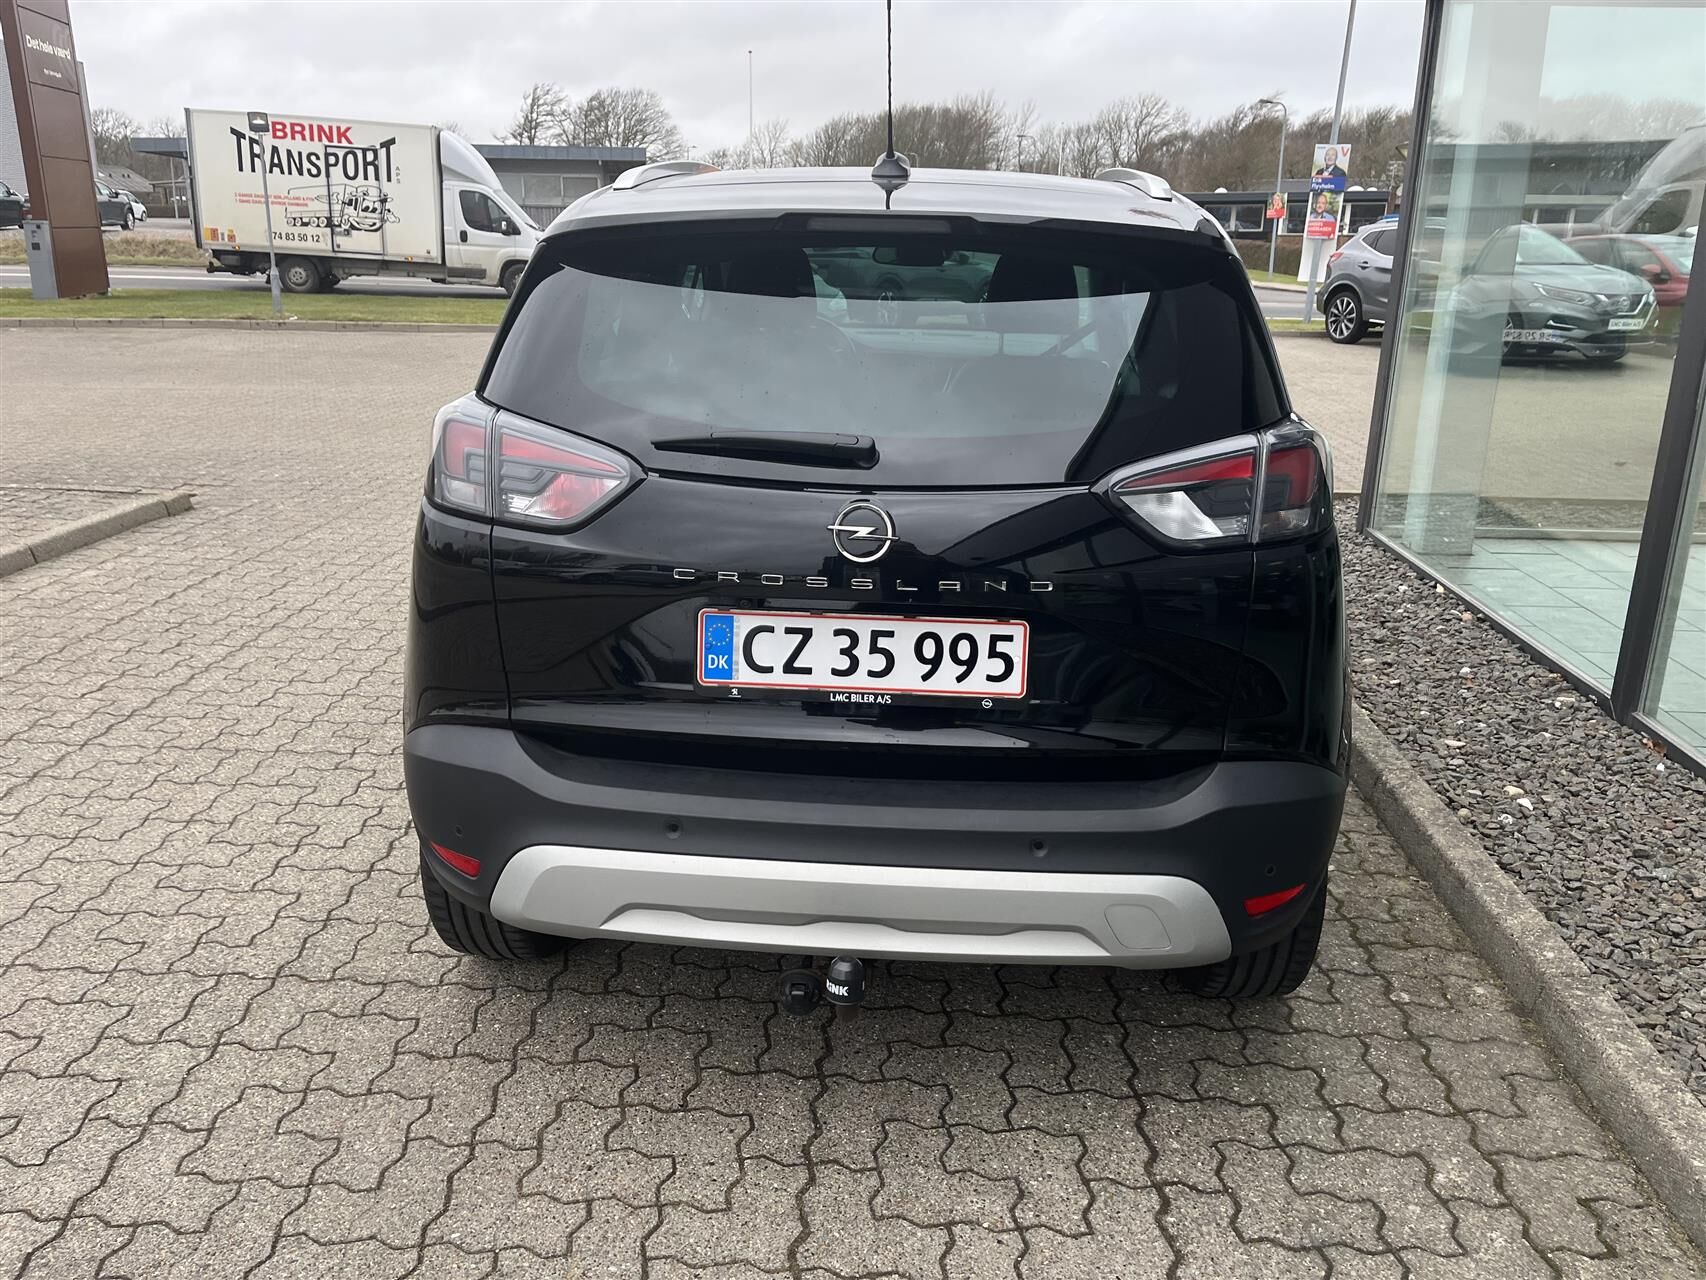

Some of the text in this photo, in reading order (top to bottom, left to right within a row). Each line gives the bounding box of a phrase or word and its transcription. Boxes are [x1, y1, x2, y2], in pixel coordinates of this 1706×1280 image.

[26, 34, 40, 50] Det
[271, 121, 353, 144] BRINK
[230, 127, 396, 183] TRANSPORT
[272, 231, 320, 243] 74 83 50 12
[673, 568, 1053, 592] CROSSLAND
[708, 654, 729, 670] DK
[742, 624, 1015, 684] CZ 35 995
[829, 692, 892, 704] LMC BILER A/S
